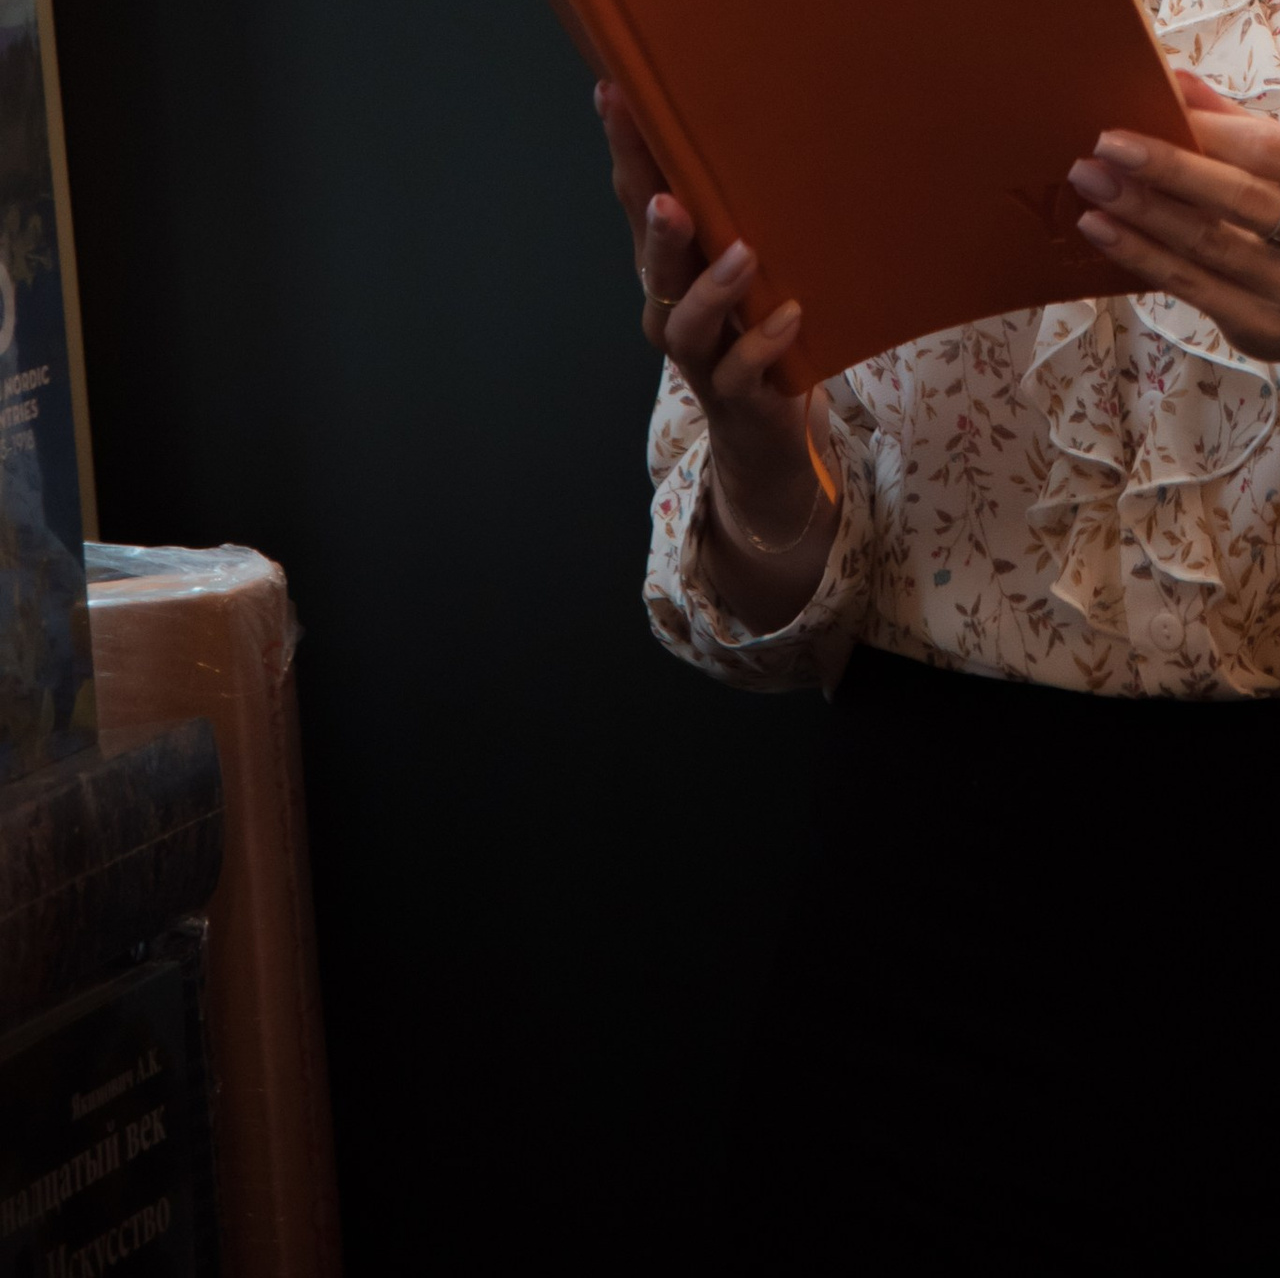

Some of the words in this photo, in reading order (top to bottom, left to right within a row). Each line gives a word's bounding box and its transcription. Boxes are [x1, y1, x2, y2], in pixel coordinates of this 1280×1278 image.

[4, 364, 51, 396] NORDIC
[126, 1104, 167, 1161] век
[46, 1197, 171, 1278] Искусство
